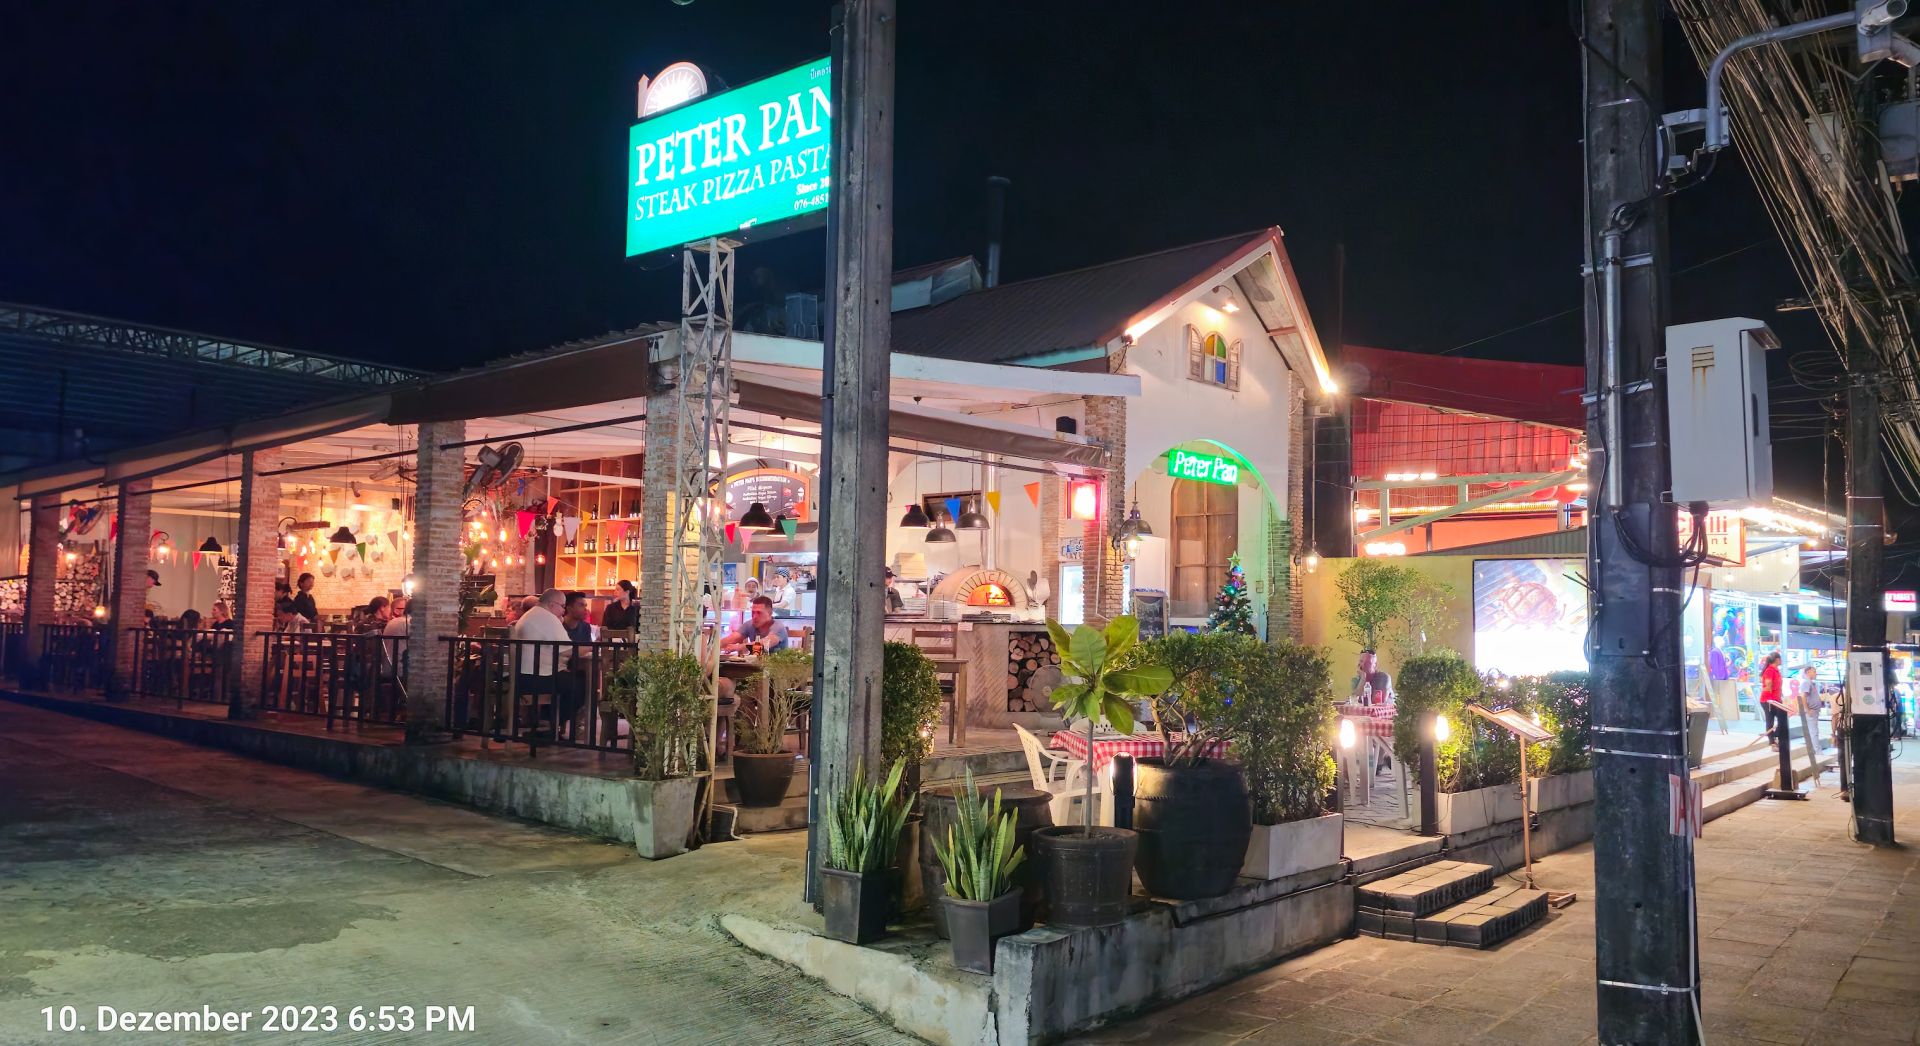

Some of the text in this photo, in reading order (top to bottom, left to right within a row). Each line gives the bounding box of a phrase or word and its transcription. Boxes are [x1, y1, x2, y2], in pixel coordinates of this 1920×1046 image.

[635, 86, 831, 187] PETER PAN
[635, 183, 698, 221] STEAK
[701, 164, 765, 204] PIZZA
[1174, 451, 1238, 483] Peter Pan
[1678, 515, 1727, 534] Clli
